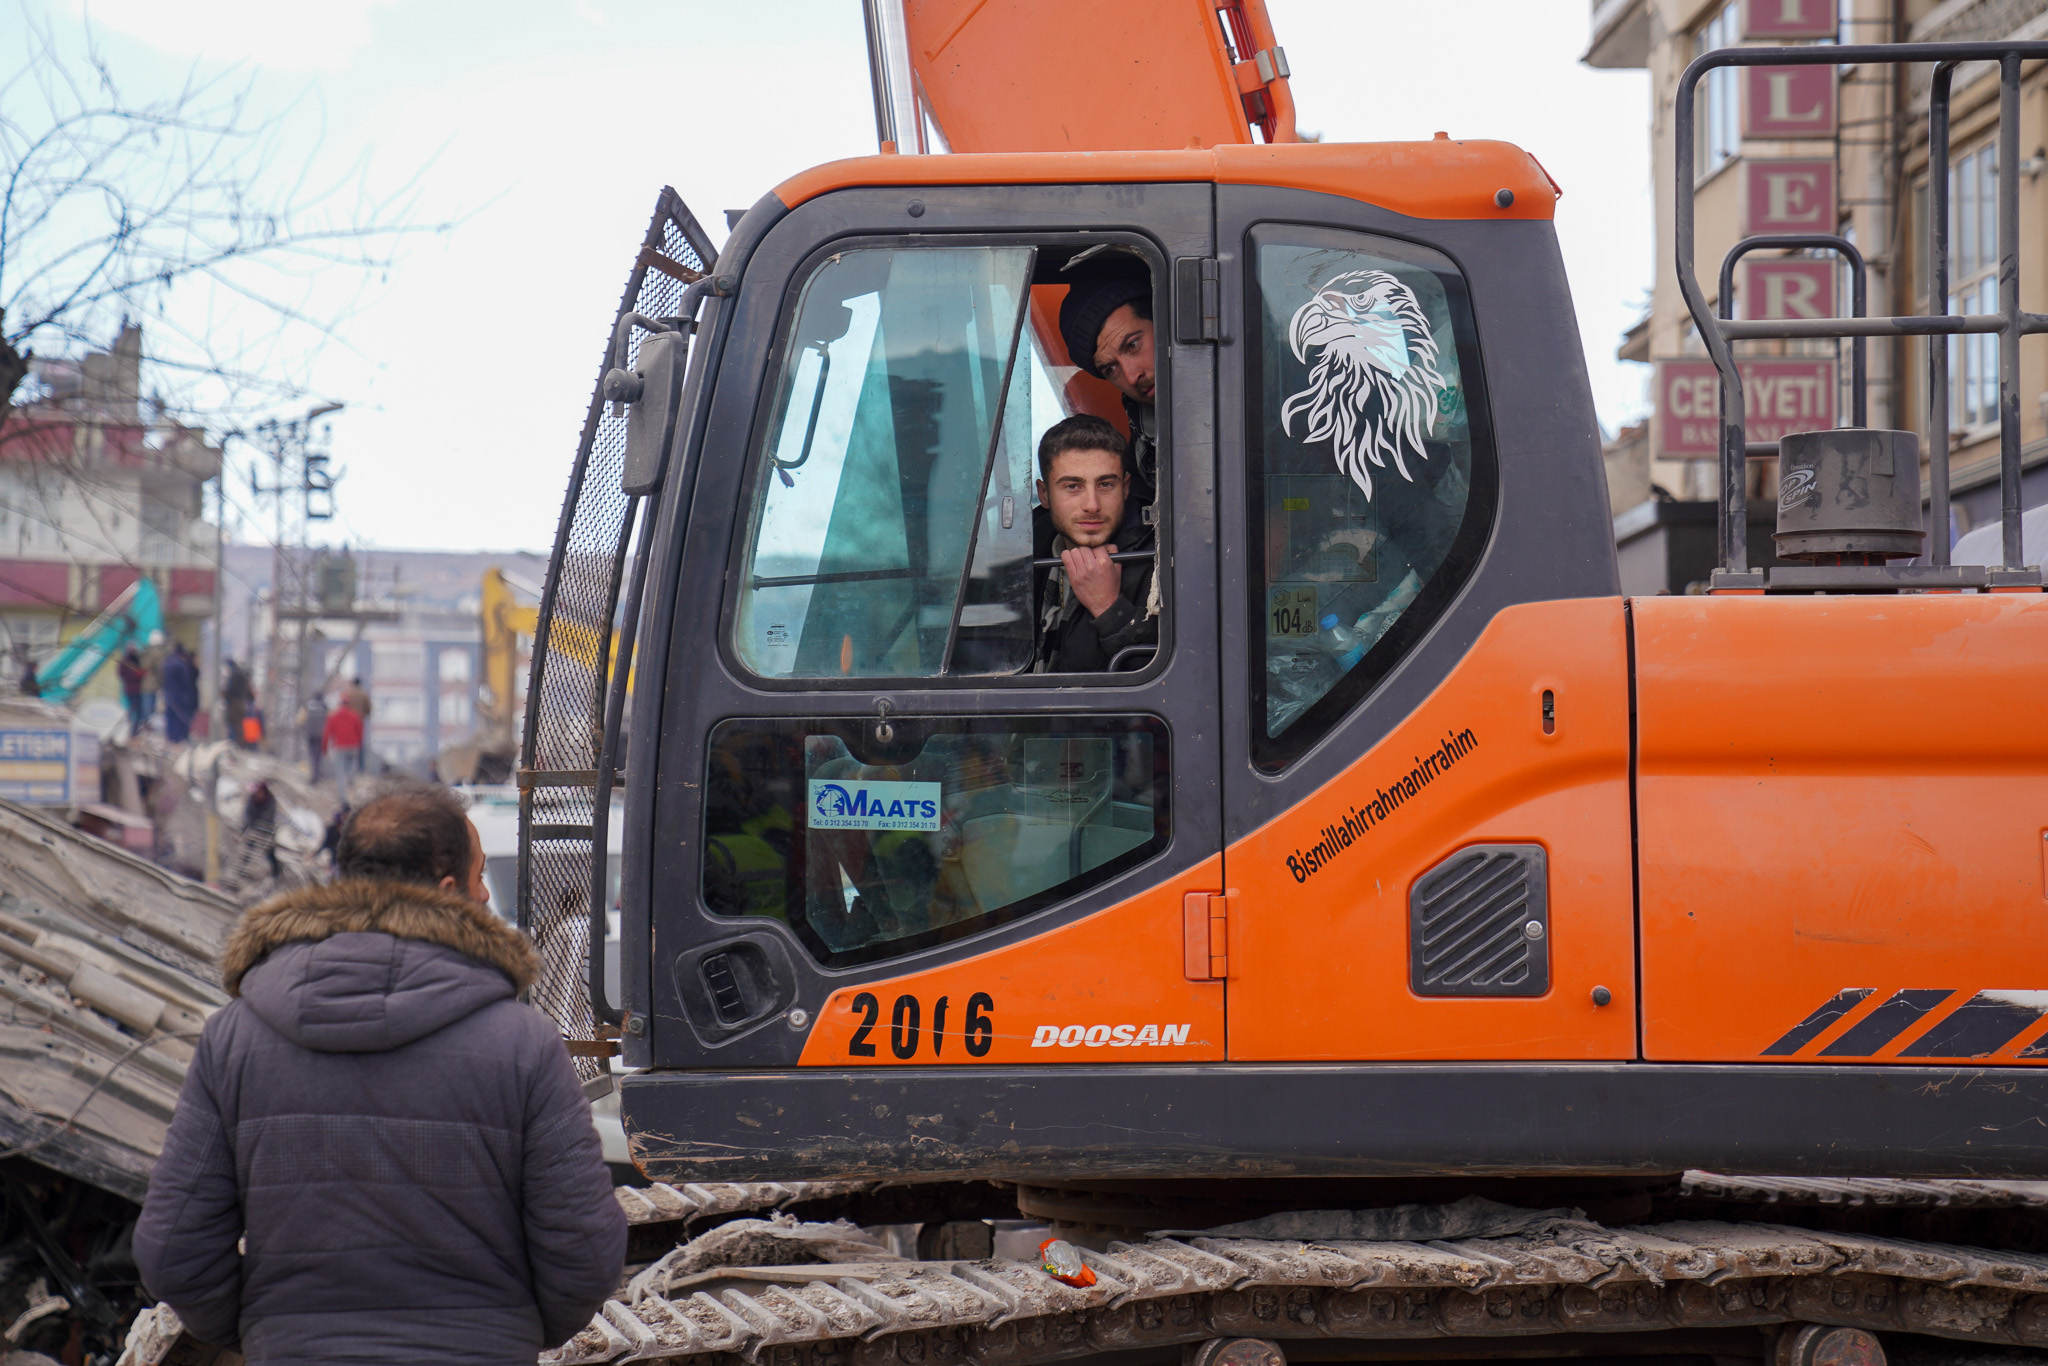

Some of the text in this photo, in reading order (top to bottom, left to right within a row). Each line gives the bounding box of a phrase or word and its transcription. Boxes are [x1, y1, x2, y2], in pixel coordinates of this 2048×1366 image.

[1669, 366, 1828, 418] CEİYETİ
[1790, 462, 1814, 470] Donaldson
[1785, 481, 1817, 504] SPIN
[1273, 608, 1314, 634] 104 dB
[819, 784, 937, 818] MAATS
[1286, 728, 1478, 883] Bismillahirrahmanirrahim
[878, 820, 890, 828] Fax:
[848, 992, 994, 1059] 2016
[1031, 1024, 1191, 1048] DOOSAN
